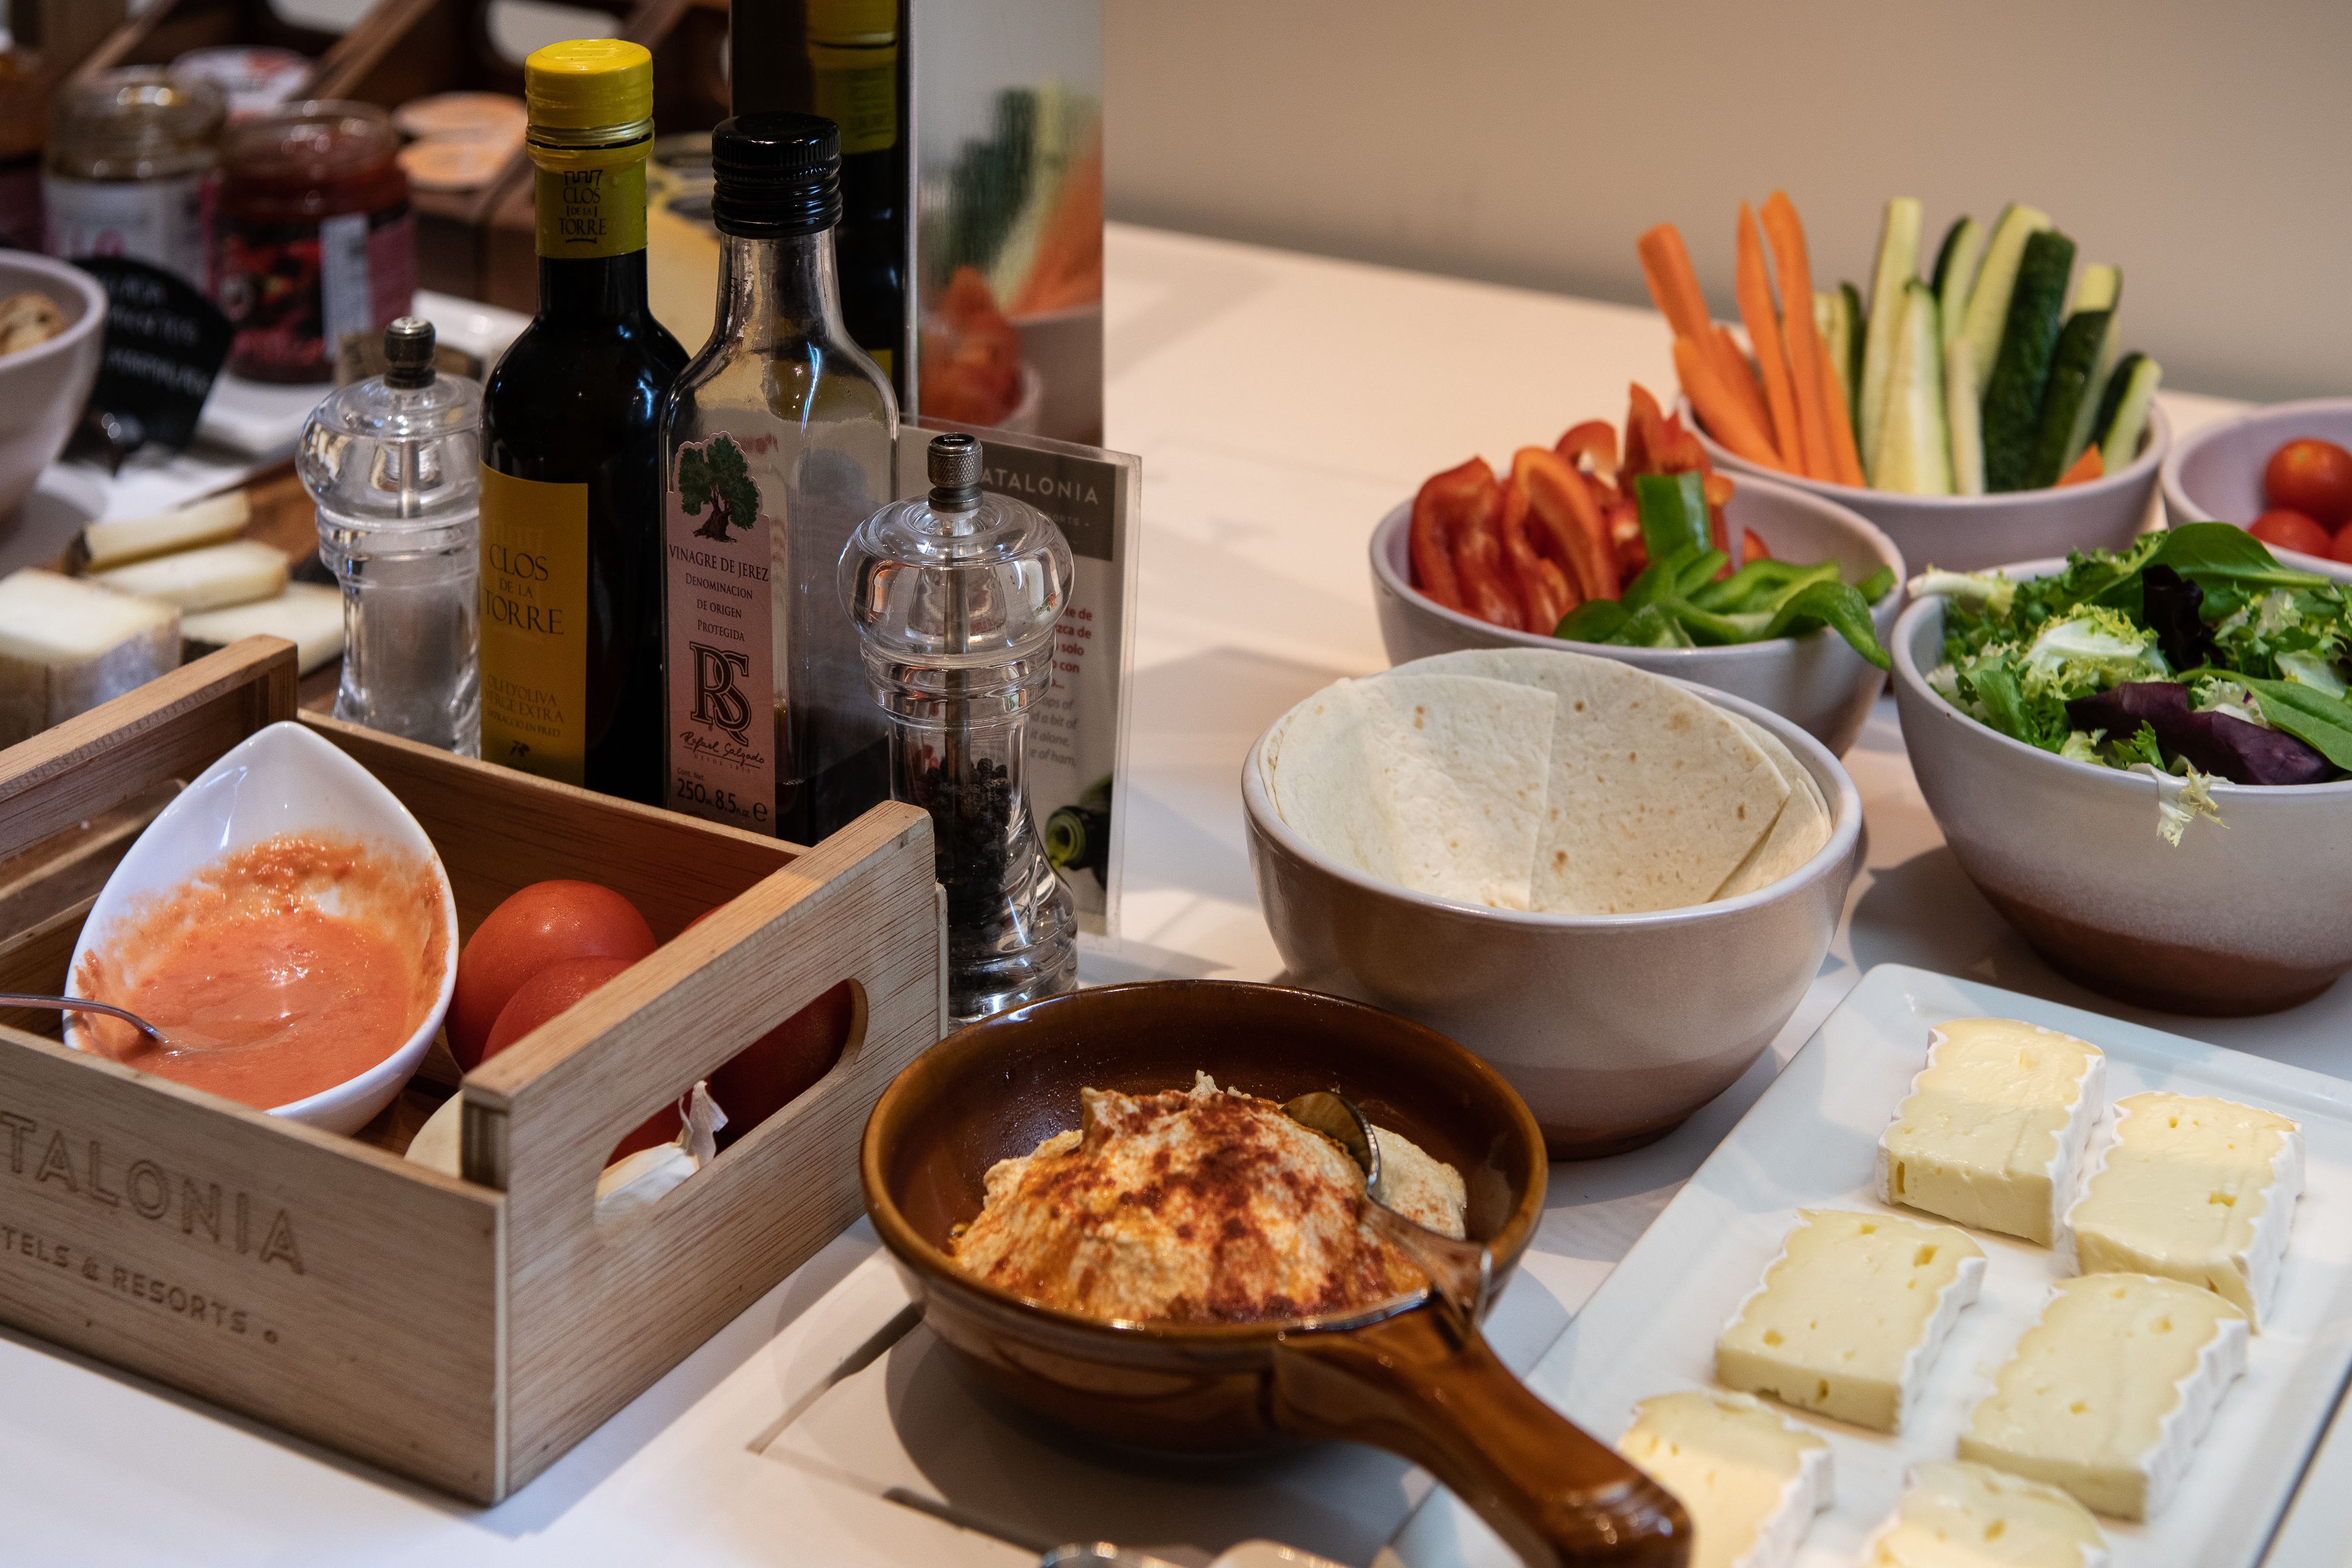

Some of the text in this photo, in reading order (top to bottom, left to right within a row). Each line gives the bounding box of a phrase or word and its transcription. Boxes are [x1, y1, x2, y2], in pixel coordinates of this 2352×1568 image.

[563, 187, 601, 204] CLOS
[571, 207, 592, 216] DE LA
[558, 218, 607, 236] TORRE
[979, 467, 1099, 505] ATALONIA
[489, 543, 549, 582] CLOS
[668, 544, 769, 582] VINAGRE DE JEREZ
[499, 578, 534, 599] DE LA
[685, 572, 753, 599] DENOMINACION
[484, 587, 564, 635] TORRE
[696, 599, 742, 619] DE ORIGEN
[1078, 607, 1093, 621] de
[697, 619, 745, 642] PROTEGIDA
[1077, 626, 1092, 639] de
[1061, 643, 1085, 657] solo
[1059, 662, 1080, 674] con
[487, 674, 503, 692] OLI
[689, 641, 751, 747] RS
[519, 702, 564, 724] EXTRA
[80, 1256, 100, 1281] &
[112, 1266, 249, 1334] RESORTS
